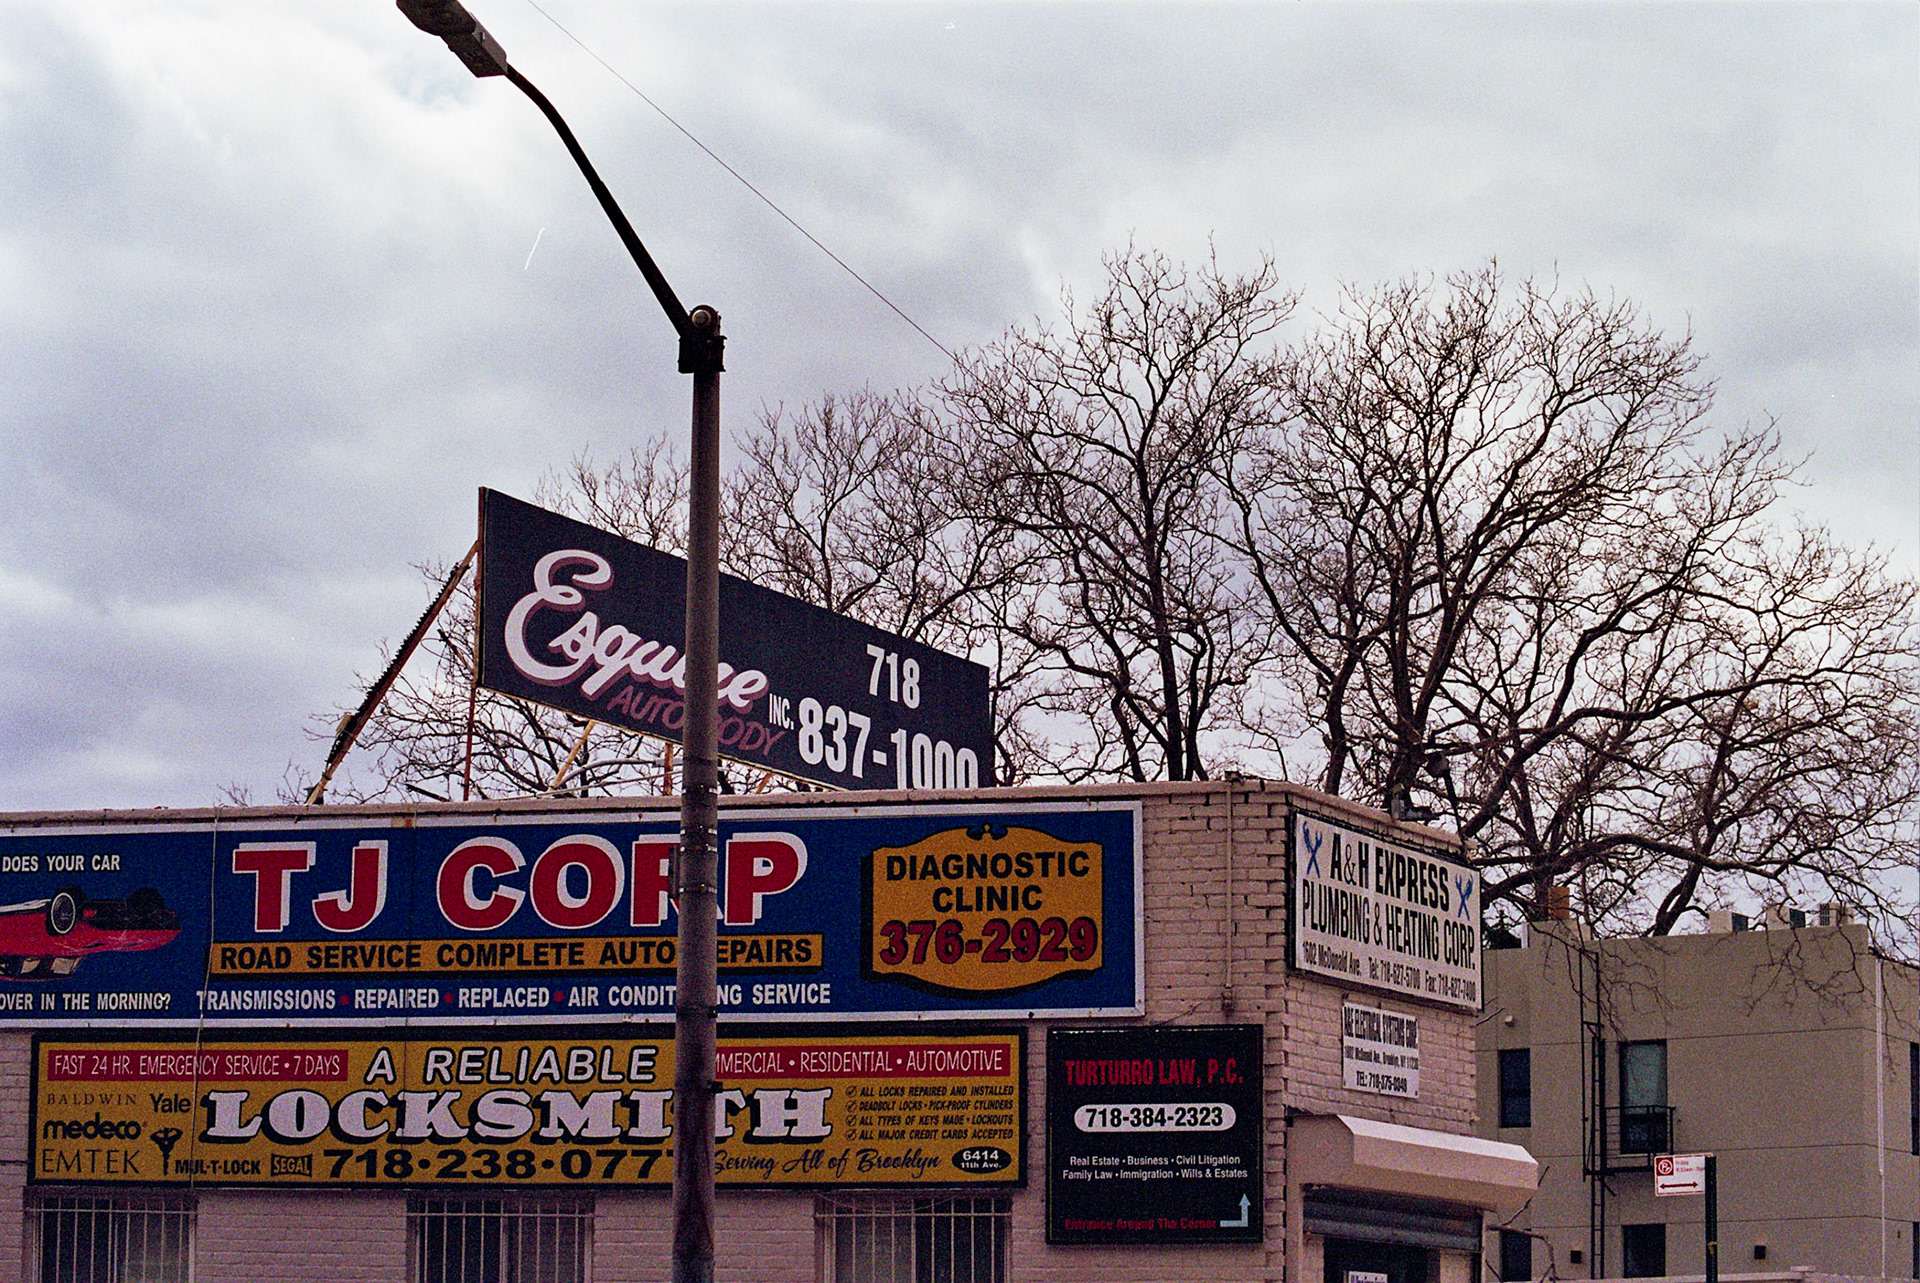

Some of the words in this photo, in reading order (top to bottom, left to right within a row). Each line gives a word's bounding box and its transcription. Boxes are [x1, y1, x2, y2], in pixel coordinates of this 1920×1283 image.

[867, 644, 920, 708] 718
[607, 685, 684, 729] AUTO
[717, 713, 786, 755] ODY
[769, 693, 794, 730] INC.
[799, 698, 978, 789] 837-1000
[2, 856, 39, 872] DOES
[46, 855, 84, 871] YOUR
[92, 855, 120, 871] CAR
[886, 851, 1090, 881] DIAGNOSTIC
[233, 840, 388, 933] TJ
[1374, 847, 1449, 912] EXPRESS
[932, 885, 1043, 913] CLINIC
[1303, 879, 1370, 945] PLUMBING
[1374, 902, 1383, 946] &
[1385, 903, 1439, 962] HEATING
[1443, 919, 1476, 970] CORP.
[880, 916, 1098, 965] 376-2929
[221, 947, 291, 970] ROAD
[307, 943, 421, 969] SERVICE
[437, 941, 584, 967] COMPLETE
[600, 940, 674, 965] AUTO
[716, 939, 812, 964] EPAIRS
[41, 993, 55, 1010] IN
[63, 993, 90, 1010] THE
[97, 992, 171, 1010] MORNING?
[196, 990, 335, 1010] TRANSMISSIONS
[355, 988, 439, 1009] REPAIRED
[458, 986, 549, 1008] REPLACED
[569, 986, 598, 1006] AIR
[608, 984, 741, 1006] CONDITNG
[753, 983, 831, 1004] SERVICE
[55, 1055, 86, 1075] FAST
[91, 1055, 107, 1075] 24
[112, 1055, 133, 1075] HR.
[140, 1054, 218, 1076] EMERGENCY
[225, 1055, 280, 1075] SERVICE
[293, 1055, 301, 1075] 7
[305, 1054, 340, 1076] DAYS
[365, 1047, 396, 1083] A
[424, 1047, 658, 1084] RELIABLE
[716, 1052, 784, 1075] MERCIAL
[800, 1050, 893, 1073] RESIDENTIAL
[906, 1049, 1002, 1071] AUTOMOTIVE
[1065, 1059, 1154, 1086] TURTURRO
[1159, 1059, 1201, 1088] LAW,
[1207, 1058, 1243, 1085] P.C.
[47, 1093, 137, 1106] BALDWIN
[150, 1094, 191, 1113] Yale
[860, 1087, 875, 1097] ALL
[878, 1086, 905, 1097] LOCKS
[908, 1086, 947, 1096] REPAIRED
[950, 1086, 967, 1096] AND
[971, 1085, 1014, 1096] INSTALLED
[859, 1101, 895, 1112] DEADBOLT
[899, 1100, 922, 1111] LOCKS
[974, 1099, 1013, 1110] CYLINDERS
[1086, 1106, 1223, 1127] 718-384-2323
[43, 1112, 142, 1140] medeco
[859, 1116, 873, 1126] ALL
[877, 1115, 901, 1126] TYPES
[905, 1115, 916, 1125] OF
[919, 1115, 939, 1125] KEYS
[943, 1115, 965, 1125] MADE
[971, 1114, 1013, 1125] LOCKOUTS
[859, 1130, 874, 1140] ALL
[877, 1129, 905, 1140] MAJOR
[909, 1129, 938, 1140] CREDIT
[941, 1129, 968, 1140] CARDS
[971, 1128, 1013, 1139] ACCEPTED
[42, 1149, 140, 1174] EMTEK
[273, 1156, 311, 1175] SEGAL
[714, 1151, 779, 1178] Serving
[783, 1149, 823, 1174] All
[828, 1149, 850, 1178] of
[856, 1146, 942, 1179] Brooklyn
[960, 1161, 979, 1169] 11th
[982, 1161, 1002, 1169] Ave.
[963, 1150, 999, 1161] 6414
[1070, 1156, 1090, 1166] Real
[1092, 1156, 1120, 1166] Estate
[1127, 1156, 1169, 1165] Business
[1176, 1155, 1196, 1165] Civil
[1198, 1155, 1241, 1167] Litigation
[1063, 1170, 1092, 1181] Family
[1094, 1170, 1113, 1179] Law
[1120, 1169, 1173, 1181] Immigration
[1180, 1169, 1203, 1178] Wills
[1205, 1169, 1212, 1178] &
[1214, 1169, 1248, 1178] Estates
[1064, 1218, 1113, 1230] Entrance
[1116, 1218, 1154, 1230] Around
[1157, 1218, 1177, 1229] The
[1180, 1217, 1217, 1229] Corner
